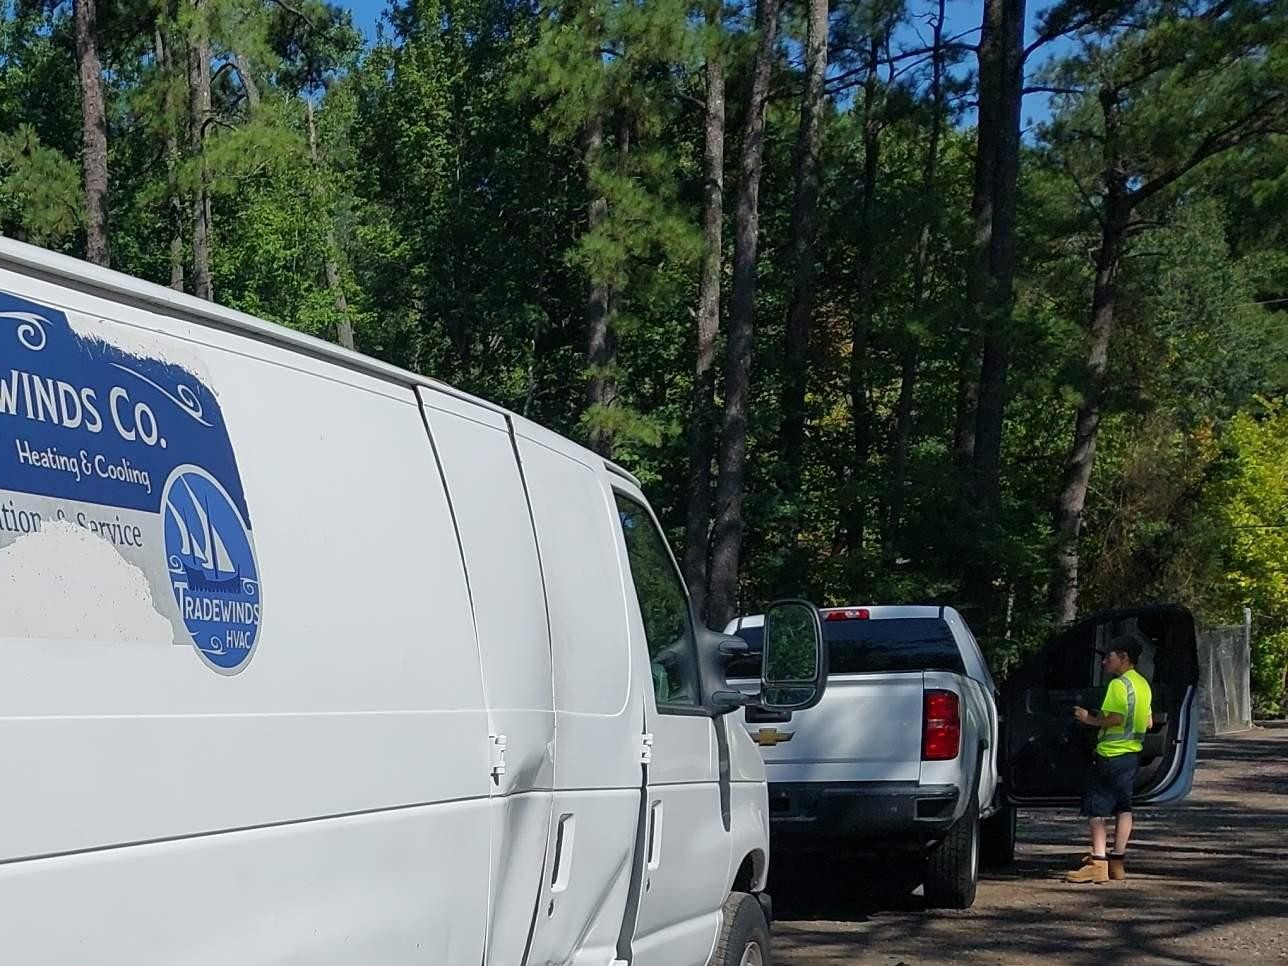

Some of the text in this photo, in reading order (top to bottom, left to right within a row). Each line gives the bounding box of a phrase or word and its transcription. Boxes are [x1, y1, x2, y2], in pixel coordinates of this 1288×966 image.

[15, 438, 152, 494] Heating & Cooling
[173, 581, 260, 625] TRADEWINDS
[225, 629, 252, 650] HVAC
